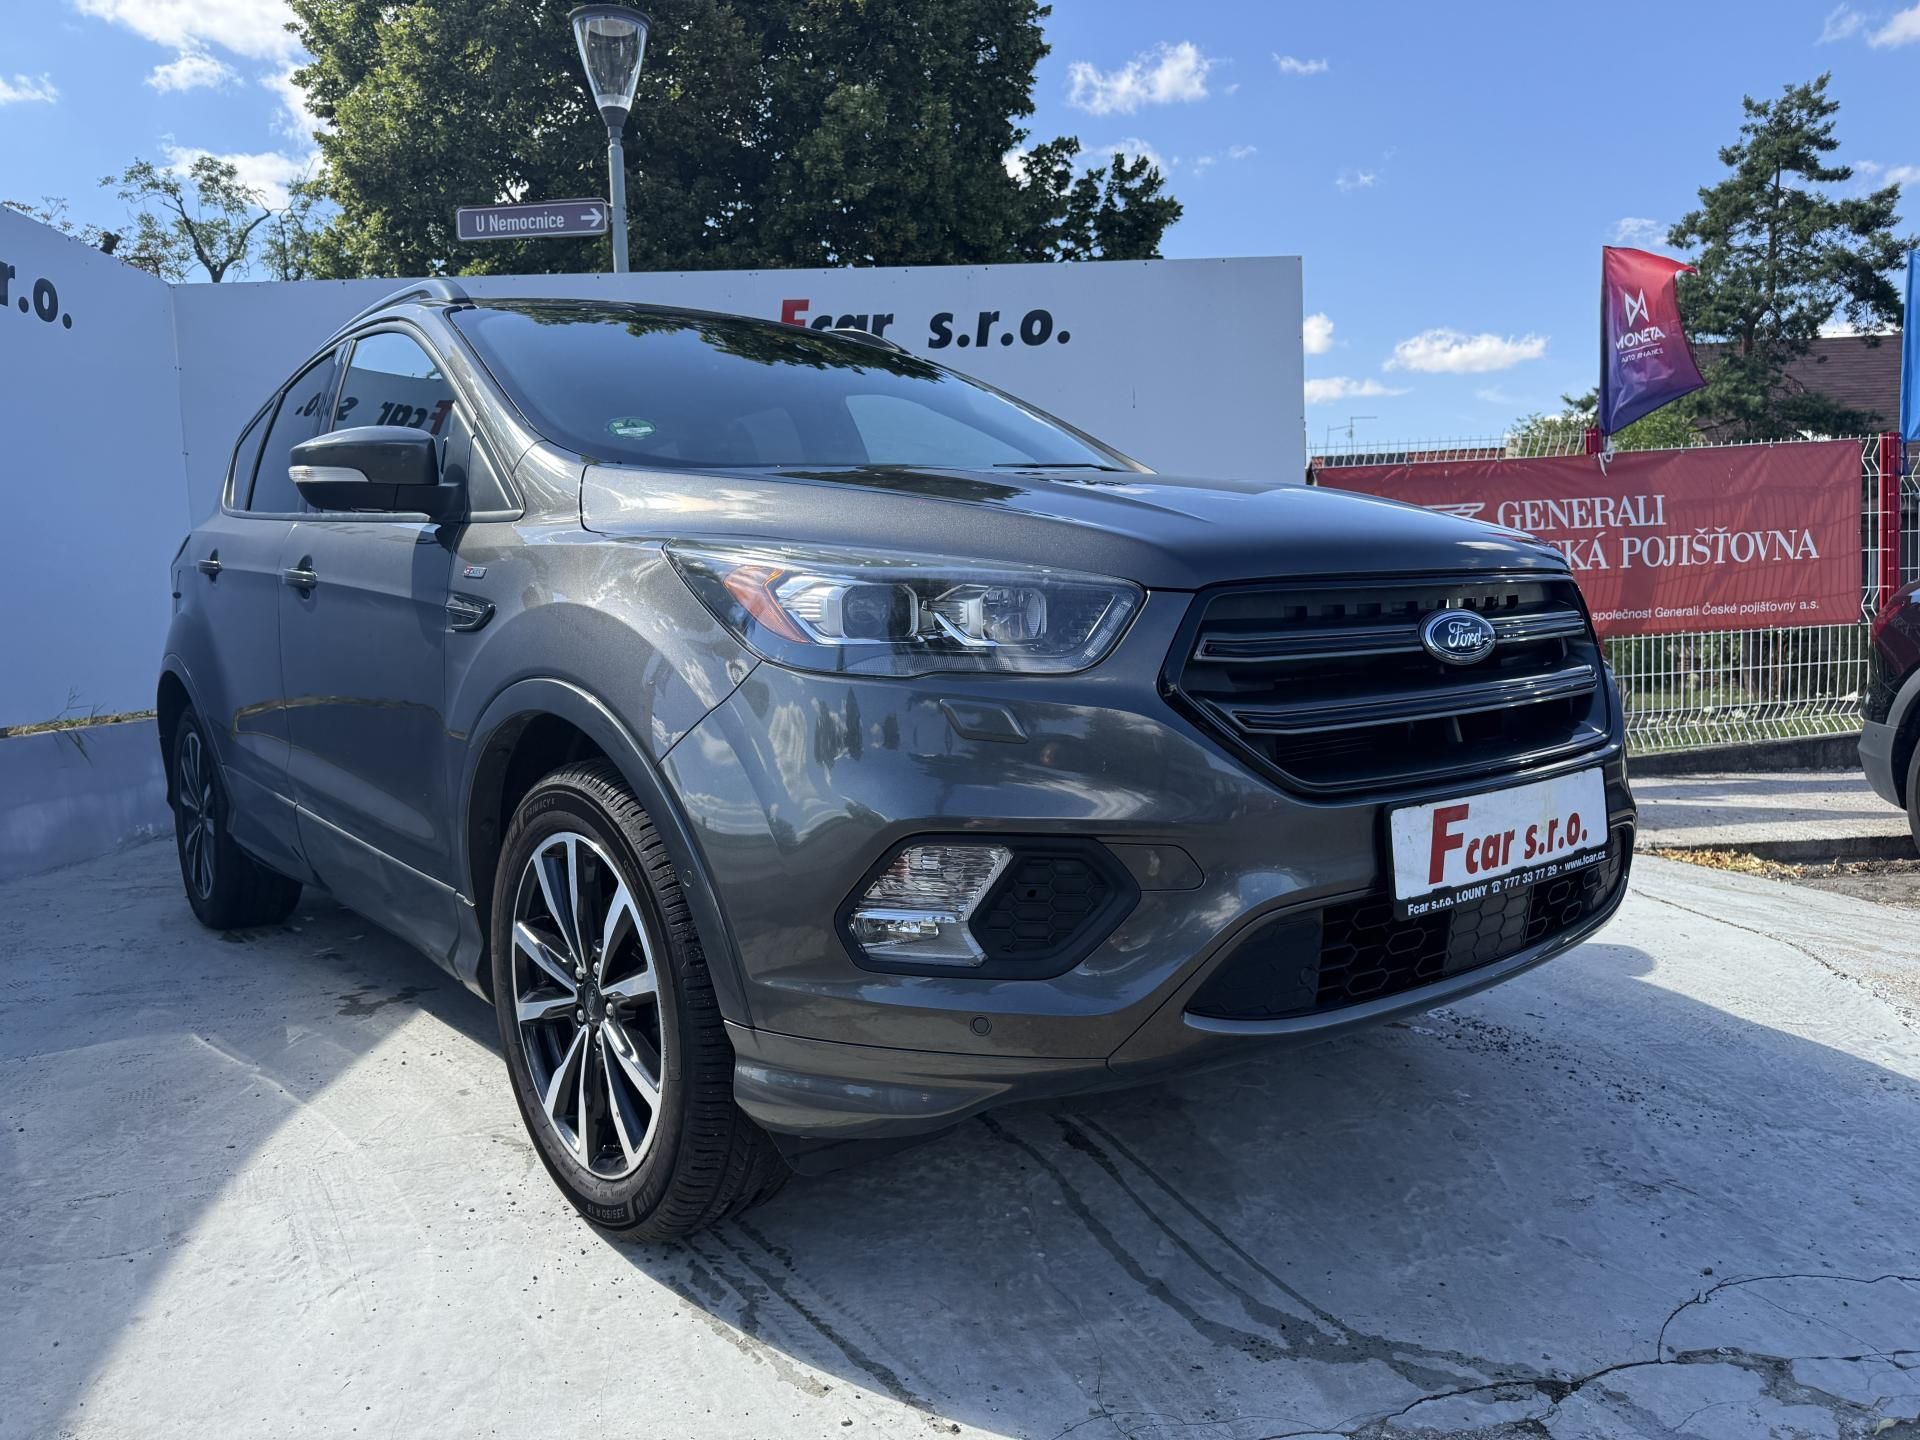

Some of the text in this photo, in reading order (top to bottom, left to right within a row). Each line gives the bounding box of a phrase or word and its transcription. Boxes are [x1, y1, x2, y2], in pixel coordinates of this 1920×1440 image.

[475, 211, 565, 232] U Nemocnice
[928, 309, 1071, 349] s.r.o.
[1615, 326, 1667, 350] MONETA
[1497, 494, 1668, 532] GENERALI
[1619, 526, 1820, 568] POJIŠŤOVNA
[1592, 600, 1820, 622] společnost Generali České pojišťovny a.s.
[1447, 621, 1482, 648] Ford
[1428, 803, 1588, 885] Fcar s.r.o.
[1407, 850, 1606, 916] Fcar s.r.o. LOUNY 777 33 77 29 www.fcar.cz
